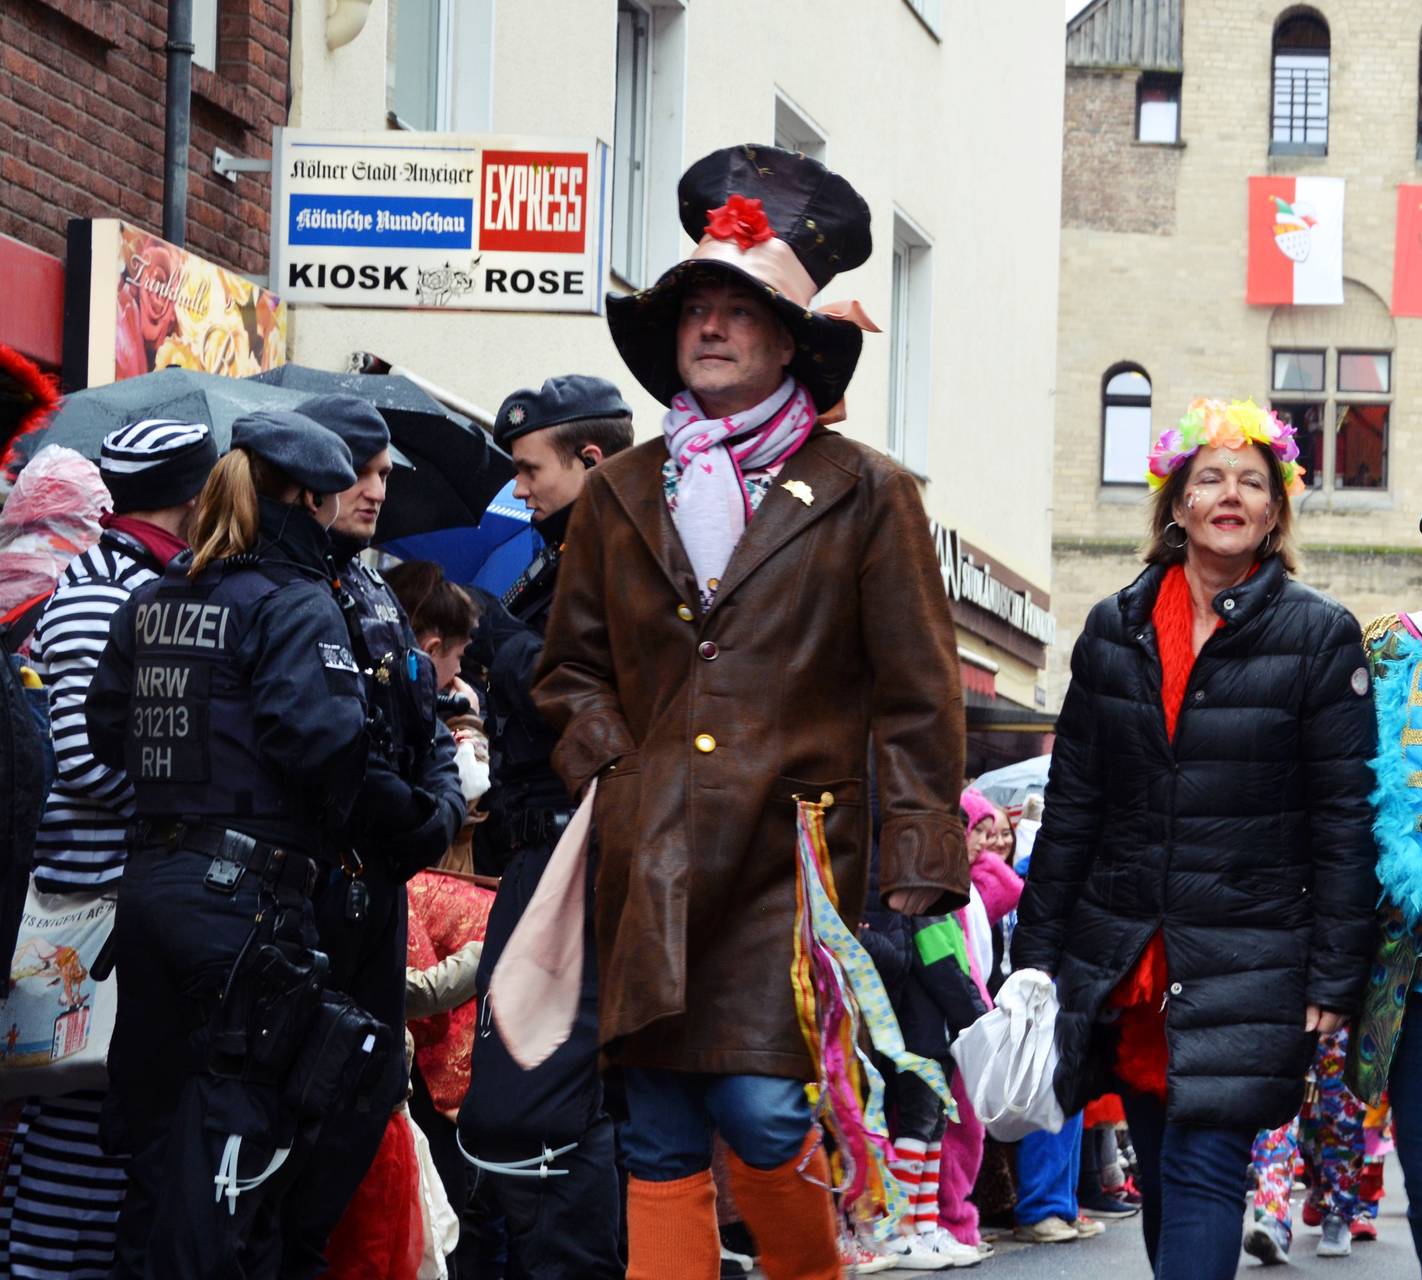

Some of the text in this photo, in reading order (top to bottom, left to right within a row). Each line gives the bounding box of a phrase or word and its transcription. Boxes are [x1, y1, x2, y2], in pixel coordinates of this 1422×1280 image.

[290, 159, 348, 180] Kölner
[484, 164, 582, 232] EXPRESS
[289, 263, 584, 294] KIOSK ROSE
[135, 602, 229, 649] POLIZEI
[136, 666, 190, 698] NRW
[134, 706, 189, 738] 31213
[141, 746, 172, 778] RH
